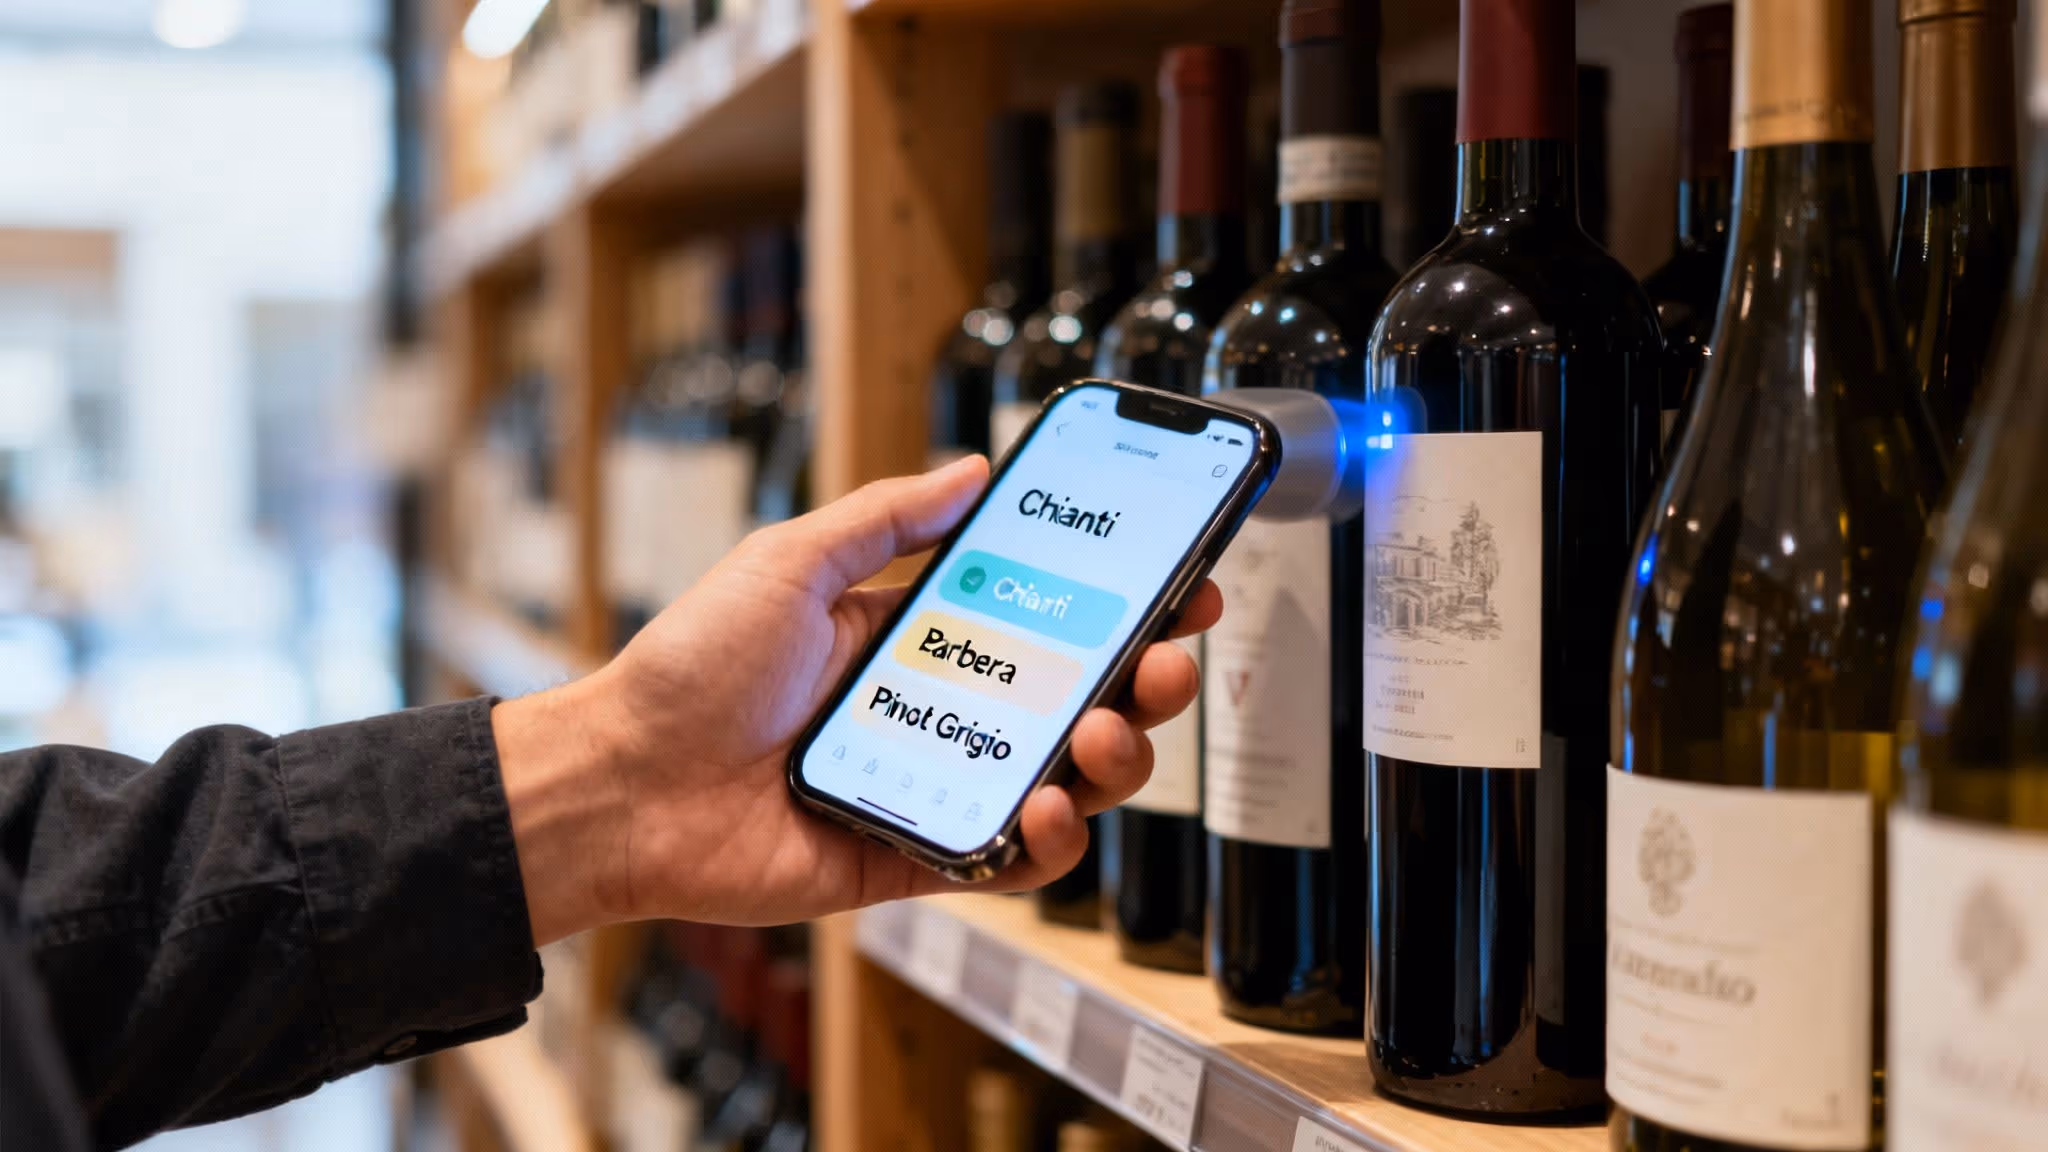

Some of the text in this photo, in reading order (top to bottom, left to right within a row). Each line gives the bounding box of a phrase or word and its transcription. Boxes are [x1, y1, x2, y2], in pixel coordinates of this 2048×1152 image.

[1019, 489, 1121, 538] Chianti
[993, 576, 1073, 619] Chianti
[918, 627, 1017, 685] Barbera
[869, 685, 1012, 760] Pinot Grigio
